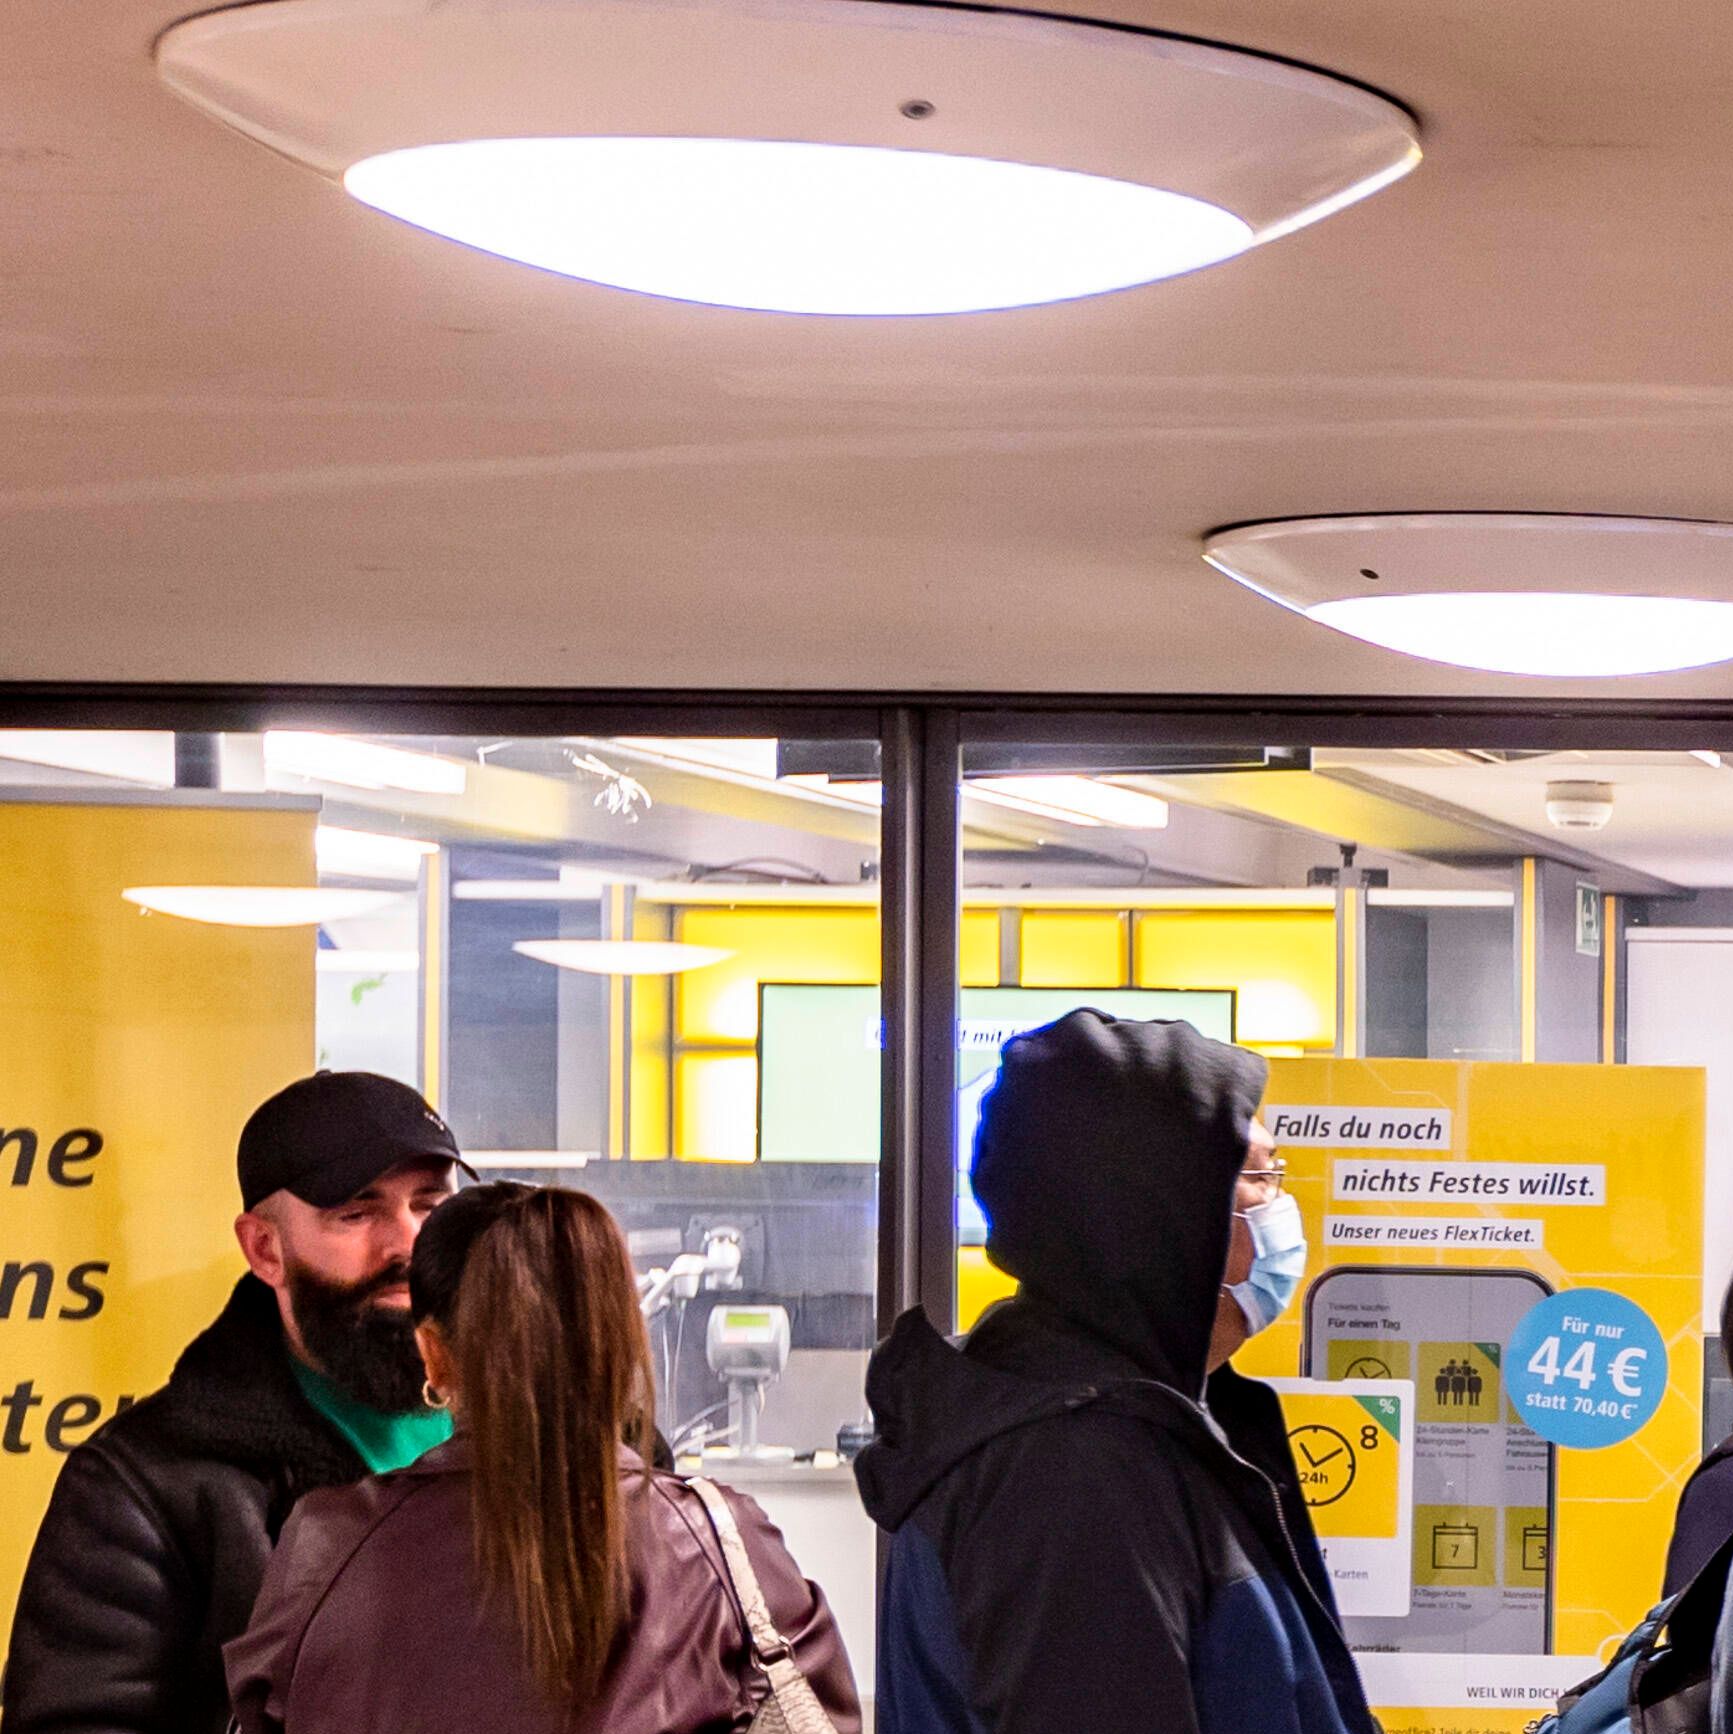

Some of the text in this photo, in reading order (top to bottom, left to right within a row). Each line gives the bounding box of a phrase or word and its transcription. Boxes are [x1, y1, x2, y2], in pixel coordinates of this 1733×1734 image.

[1273, 1114, 1443, 1141] Falls du noch
[1342, 1168, 1596, 1198] nichts Festes willst.
[1331, 1222, 1536, 1244] Unser neues FlexTicket.
[0, 1260, 111, 1322] ns
[1327, 1316, 1401, 1332] Für einen Tag
[1562, 1315, 1625, 1340] Für nur
[1526, 1335, 1649, 1398] 44 €
[1525, 1391, 1567, 1412] statt
[1572, 1397, 1619, 1418] 70,40
[1360, 1424, 1379, 1451] 8
[1300, 1470, 1329, 1485] 24h
[1450, 1543, 1460, 1559] 7
[1466, 1686, 1498, 1699] WEIL
[1500, 1686, 1526, 1699] WIR
[1528, 1687, 1560, 1700] DICH
